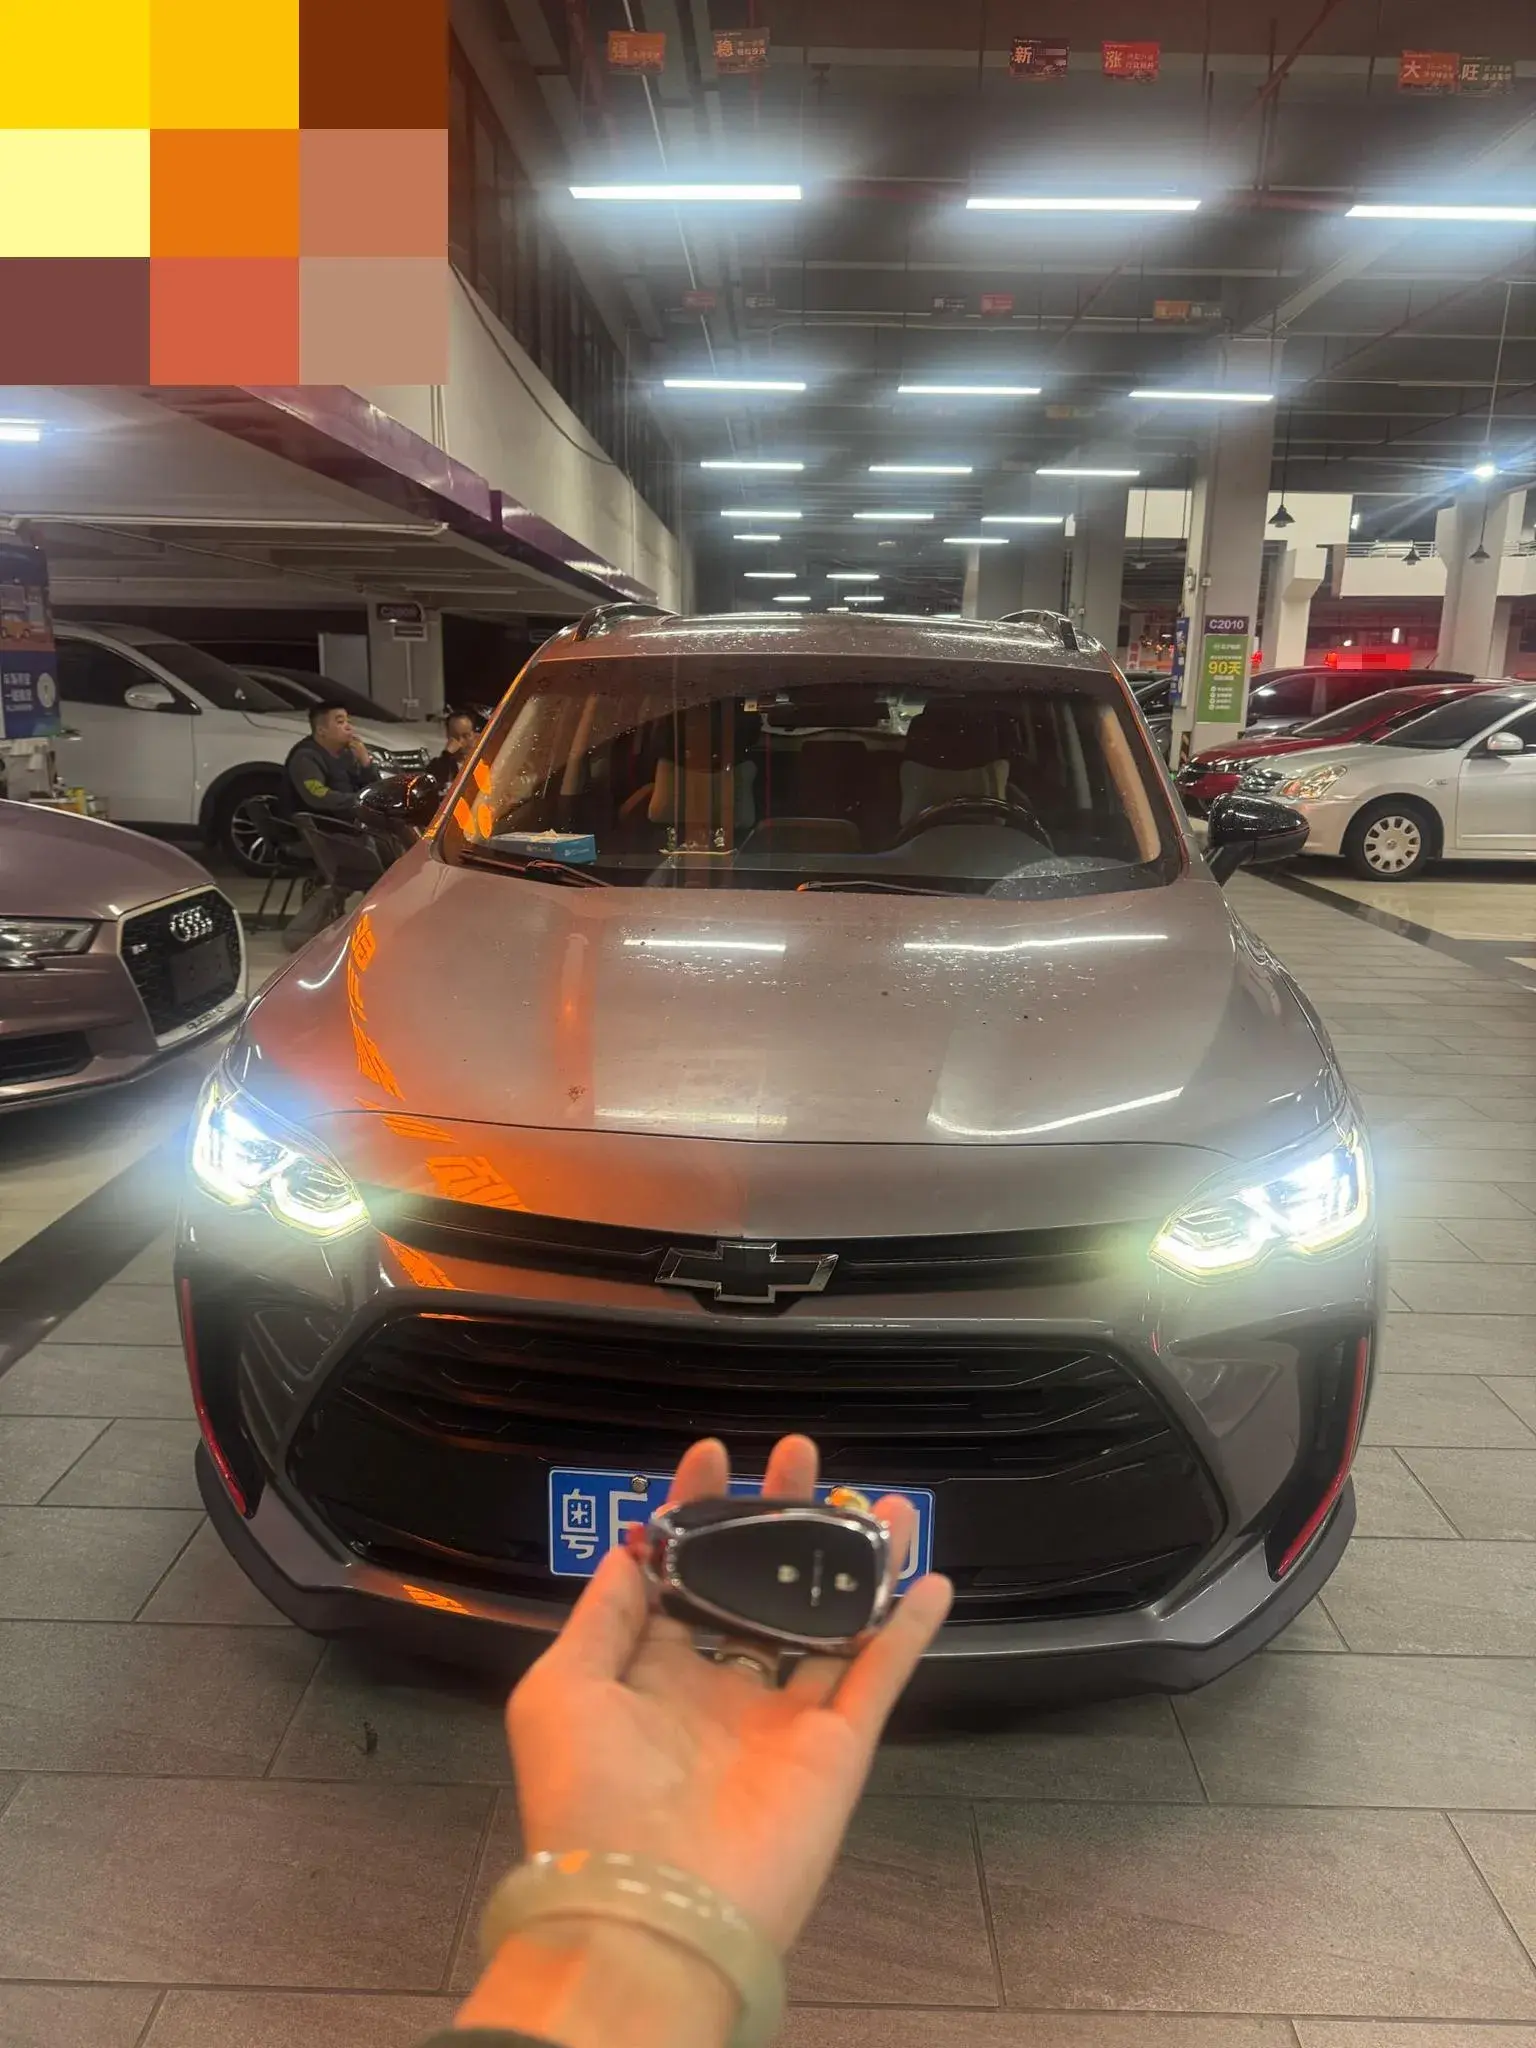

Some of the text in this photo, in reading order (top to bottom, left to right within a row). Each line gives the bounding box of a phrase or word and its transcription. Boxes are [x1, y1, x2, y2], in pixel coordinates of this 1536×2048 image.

[1014, 45, 1032, 64] 新
[1104, 50, 1122, 68] 涨
[1402, 60, 1421, 78] 大
[1462, 63, 1480, 81] 旺
[1209, 619, 1244, 630] C2010
[1208, 660, 1242, 675] 90天
